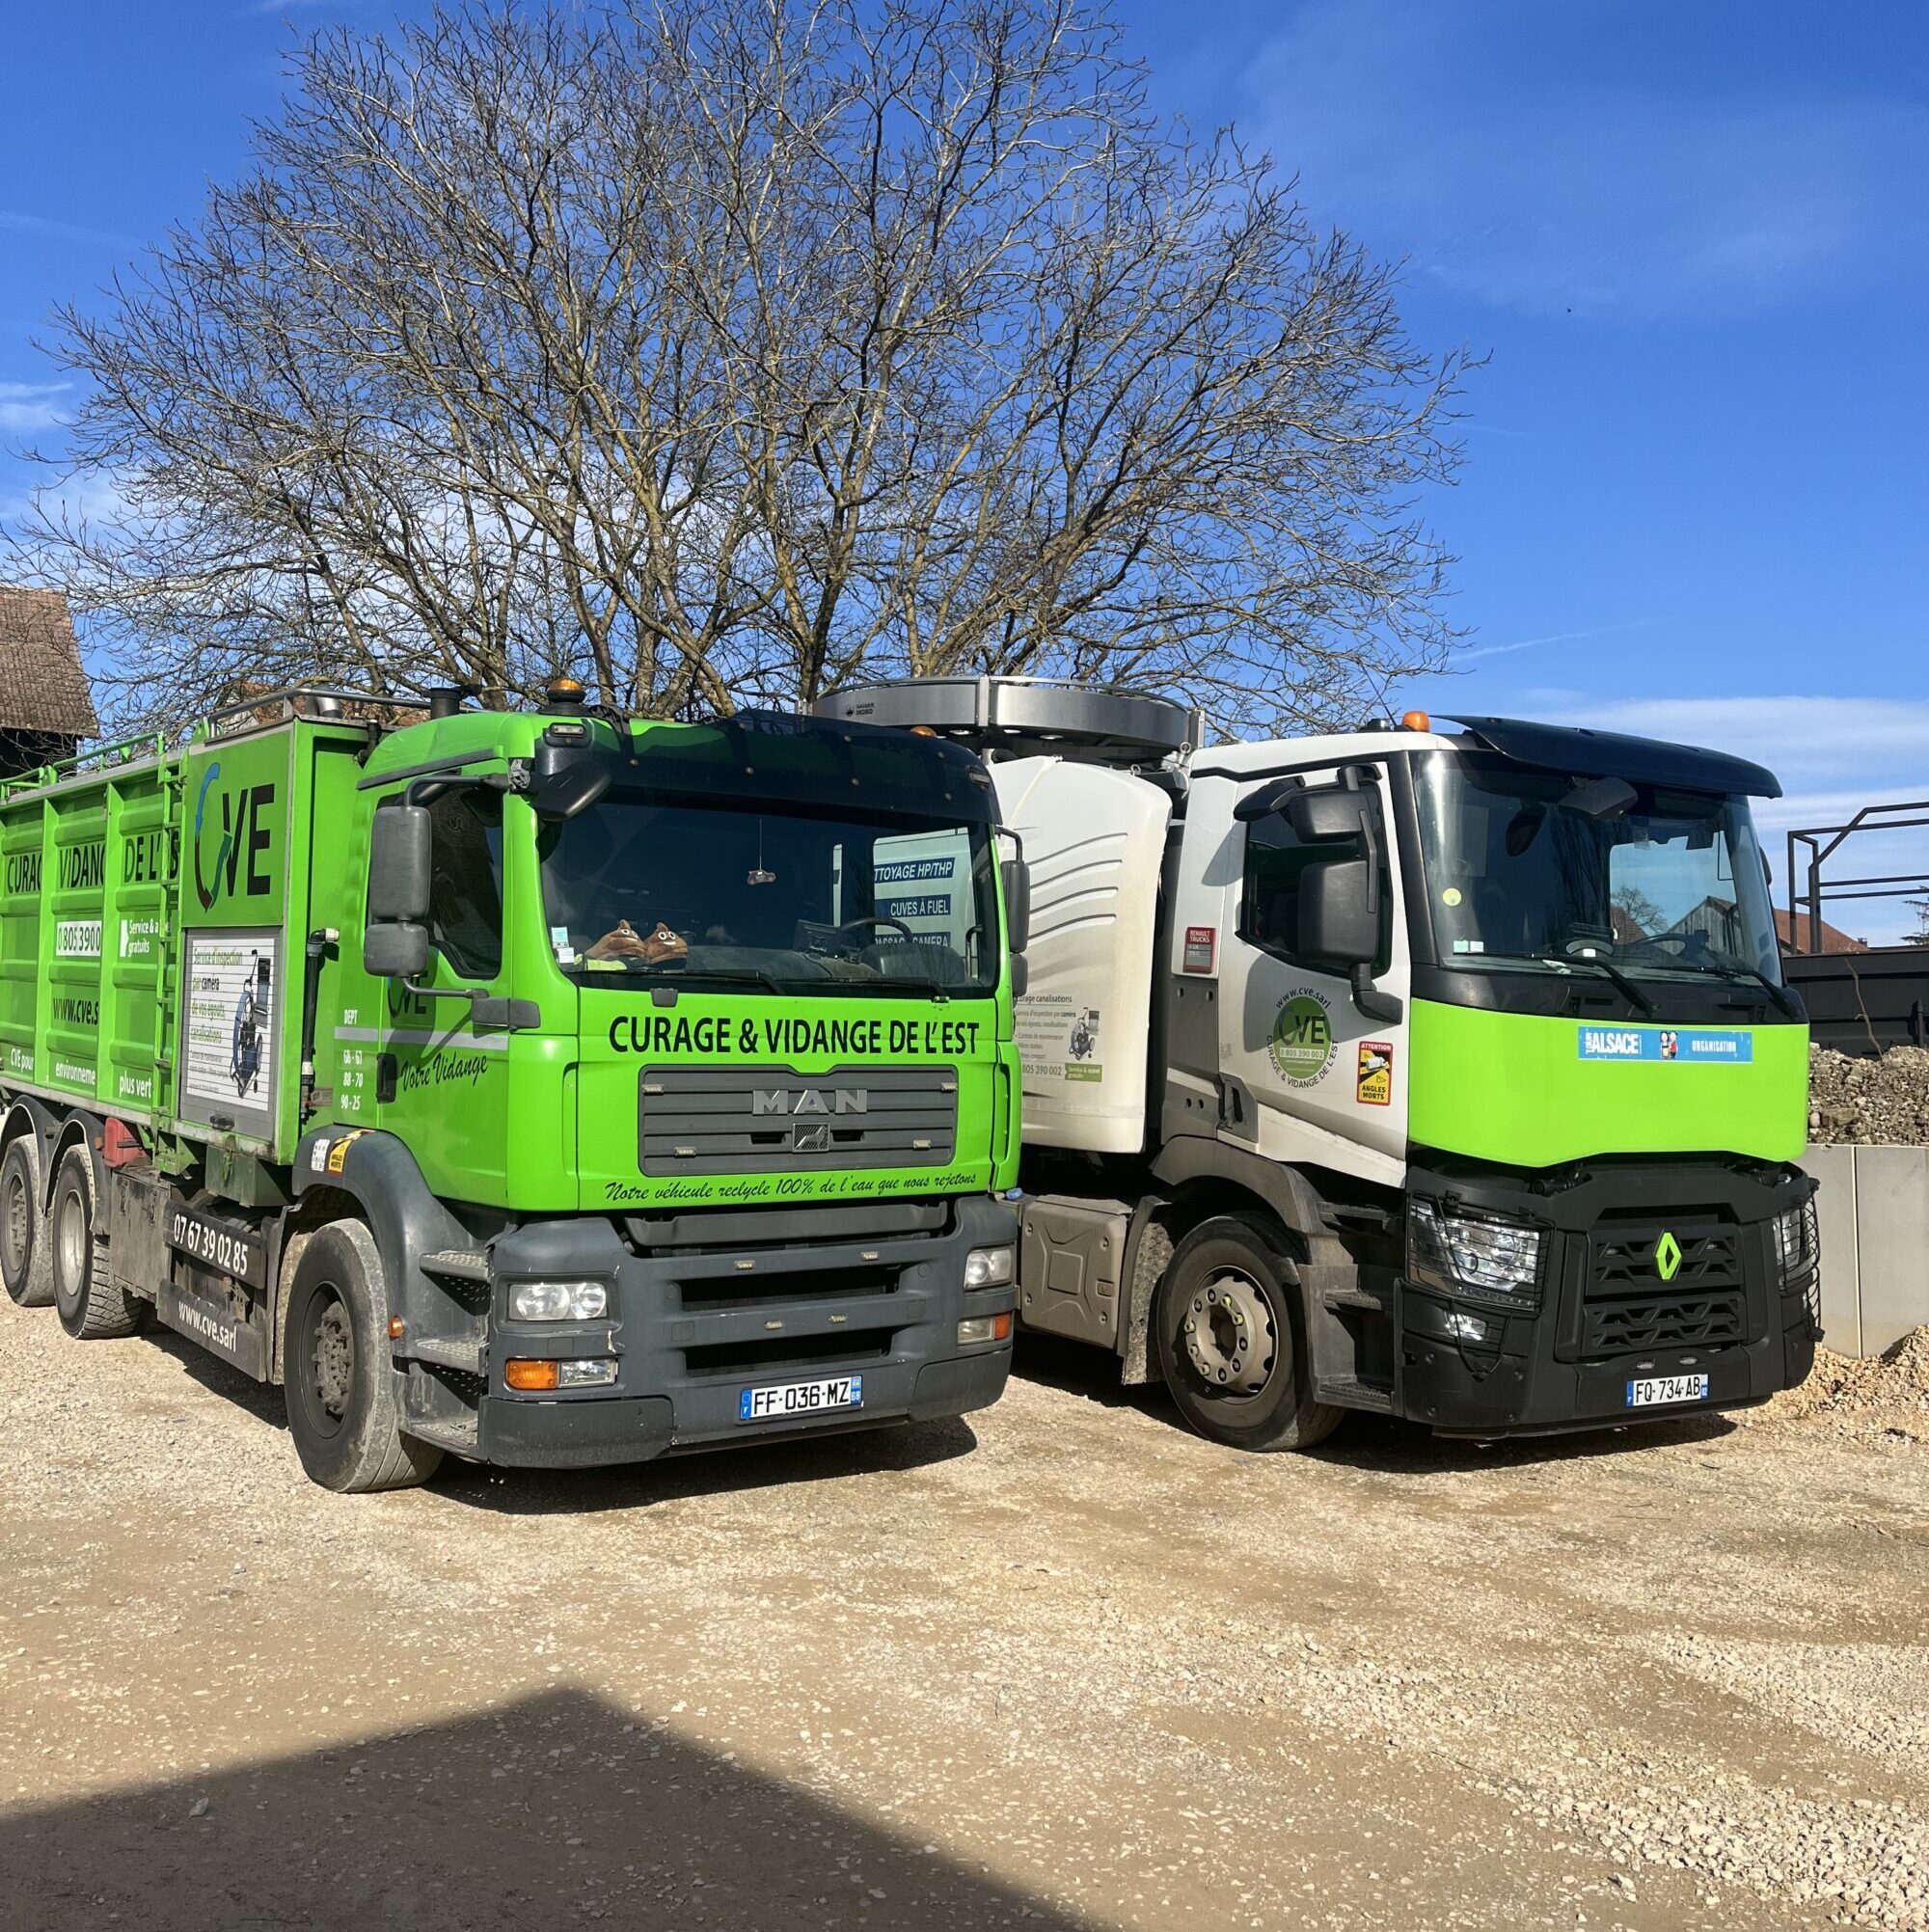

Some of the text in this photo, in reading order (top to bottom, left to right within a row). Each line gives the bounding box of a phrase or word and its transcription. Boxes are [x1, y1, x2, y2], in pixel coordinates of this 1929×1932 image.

[195, 762, 275, 914] CVE
[123, 836, 145, 884] DE
[874, 861, 953, 881] TTOYAGE HP/THP
[890, 898, 949, 916] CUVES À FUEL
[129, 919, 149, 935] Service
[875, 935, 906, 945] PASSAG
[127, 939, 150, 957] gratuits
[1036, 994, 1073, 1003] canalisations
[1275, 987, 1331, 1009] www.cve.sarl
[53, 998, 99, 1025] www.cve.s
[609, 1016, 980, 1054] CURAGE & VIDANGE DE L'EST
[1279, 1007, 1326, 1046] CVE
[1591, 1033, 1639, 1053] ALSACE
[1692, 1040, 1737, 1052] ORGANISATION
[55, 1059, 95, 1085] environneme
[120, 1071, 135, 1097] plus
[135, 1077, 151, 1099] vert
[400, 1051, 489, 1092] Votre Vidange
[1287, 1077, 1319, 1089] VIDANGE
[752, 1089, 868, 1115] MAN
[1362, 1092, 1385, 1101] MORTS
[605, 1182, 650, 1201] Notre
[655, 1181, 713, 1200] véhicule
[775, 1179, 815, 1195] 100%
[820, 1174, 834, 1193] de
[878, 1178, 900, 1195] que
[904, 1178, 930, 1188] nous
[935, 1173, 977, 1191] rejetons
[174, 1213, 249, 1276] 07 67 39 02 85
[178, 1300, 237, 1352] www.cve.sarl
